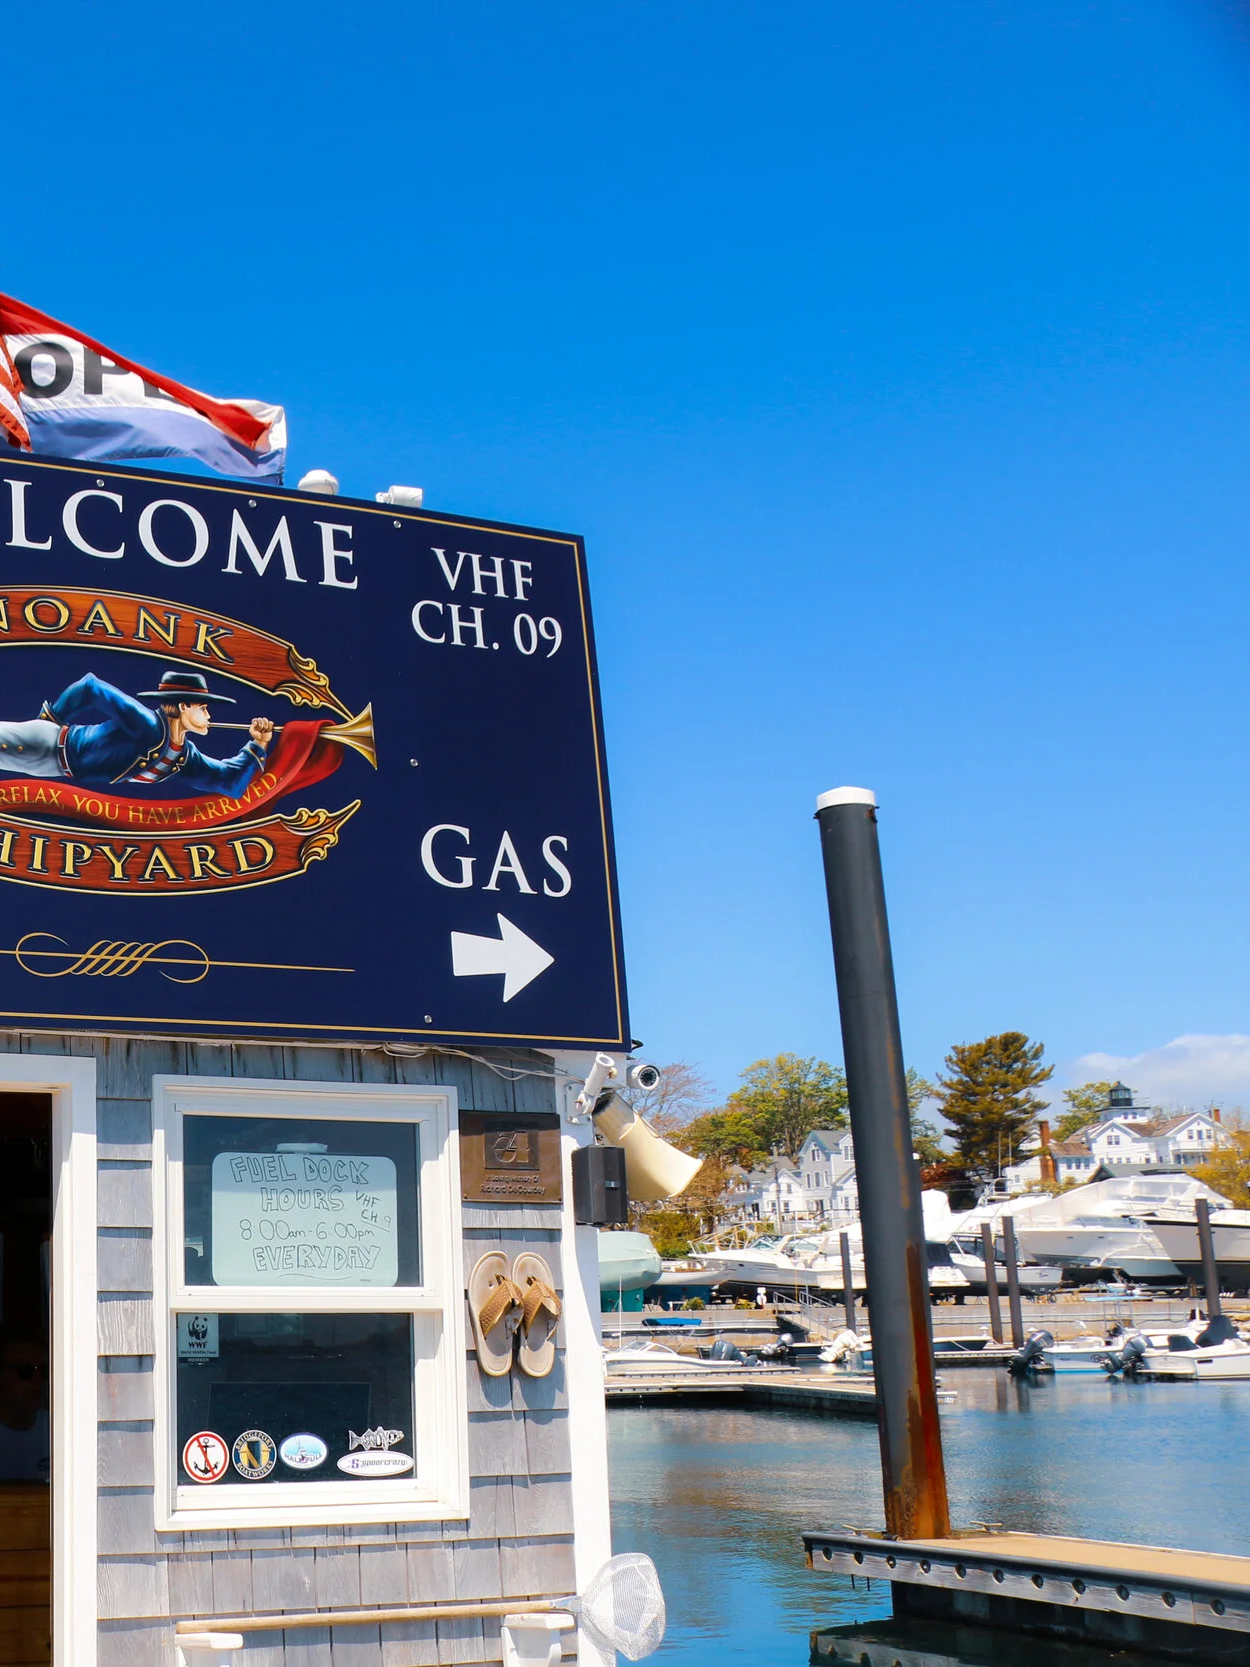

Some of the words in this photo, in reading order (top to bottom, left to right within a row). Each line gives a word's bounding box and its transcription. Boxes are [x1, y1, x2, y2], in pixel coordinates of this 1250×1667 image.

[430, 547, 533, 601] VHF
[411, 599, 500, 651] CH.
[513, 612, 563, 658] 09
[72, 794, 119, 820] YOU
[127, 806, 187, 825] HAVE
[192, 772, 284, 822] ARRIVED.
[420, 823, 572, 898] GAS
[230, 1155, 297, 1183] FUEL
[303, 1157, 370, 1185] DOCK
[261, 1185, 344, 1212] HOURS
[355, 1190, 380, 1208] VHF
[361, 1208, 378, 1223] CH
[383, 1215, 392, 1229] 9
[252, 1244, 381, 1271] EVERYDAY
[188, 1341, 207, 1349] WWF
[235, 1432, 274, 1450] BRIDGEPORT
[236, 1460, 274, 1477] BOATWORKS
